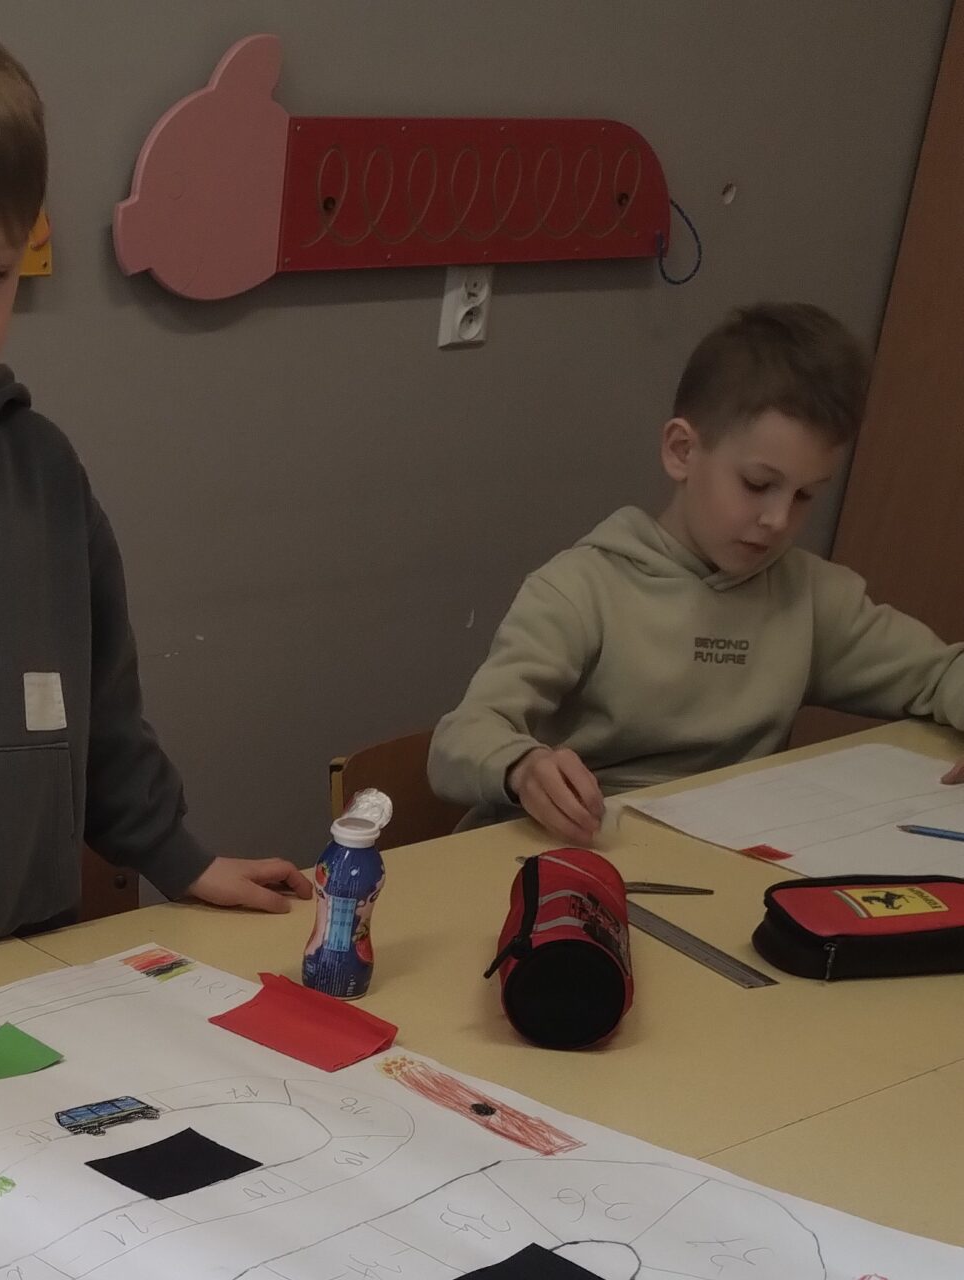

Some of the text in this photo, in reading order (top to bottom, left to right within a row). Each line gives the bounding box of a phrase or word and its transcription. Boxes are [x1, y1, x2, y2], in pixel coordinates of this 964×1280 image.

[694, 637, 749, 650] BEYOND
[694, 651, 747, 664] FUTURE
[551, 1183, 634, 1223] 36
[103, 1212, 149, 1247] 21
